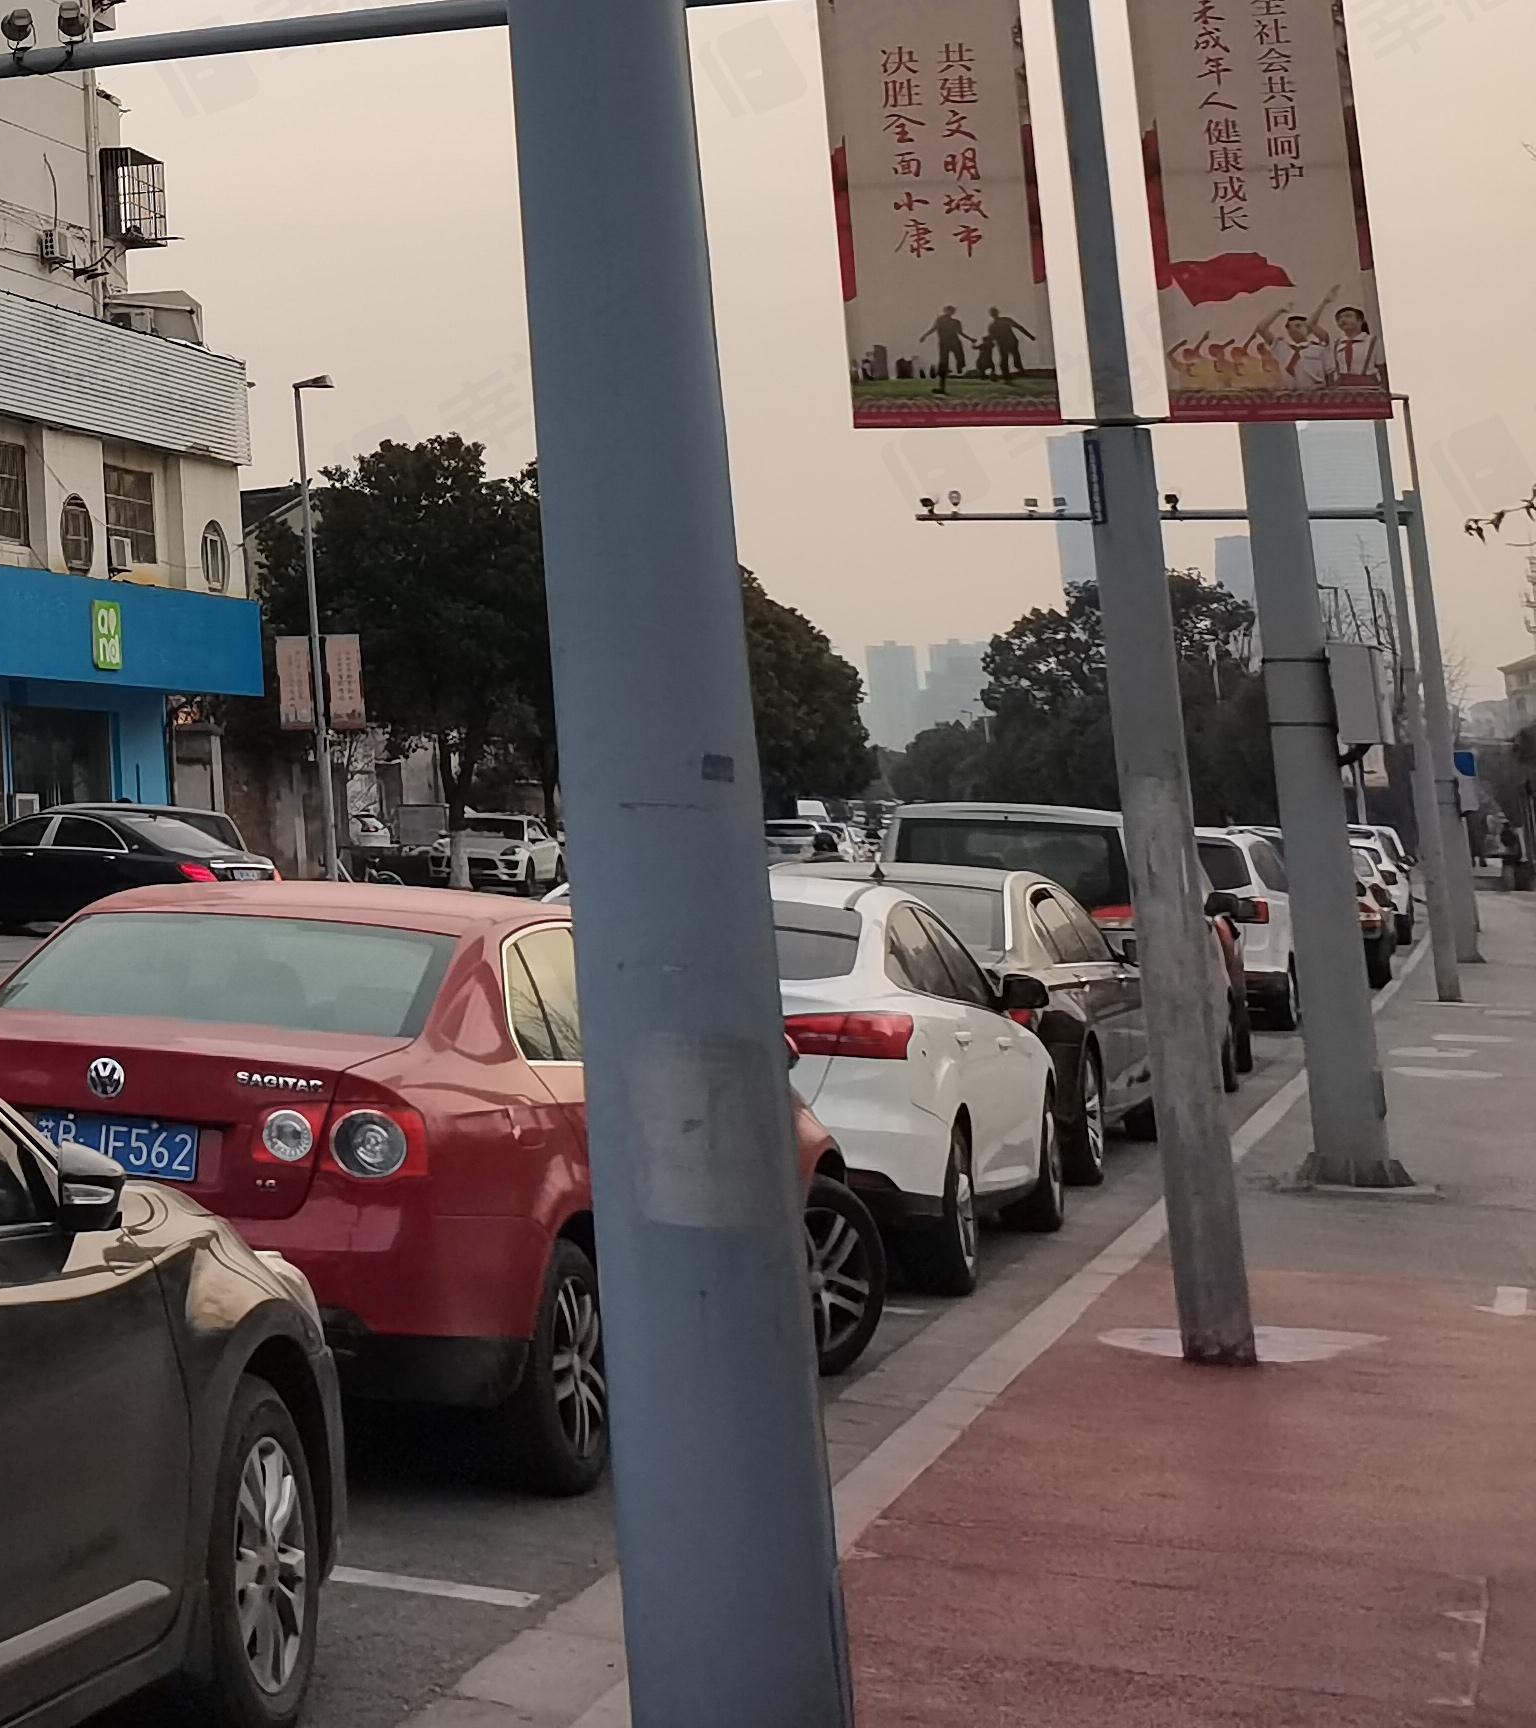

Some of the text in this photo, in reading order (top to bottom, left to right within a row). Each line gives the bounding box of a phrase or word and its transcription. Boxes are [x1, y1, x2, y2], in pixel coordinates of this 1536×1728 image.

[880, 45, 936, 258] 决胜全面小康
[936, 41, 988, 259] 共建文明城市
